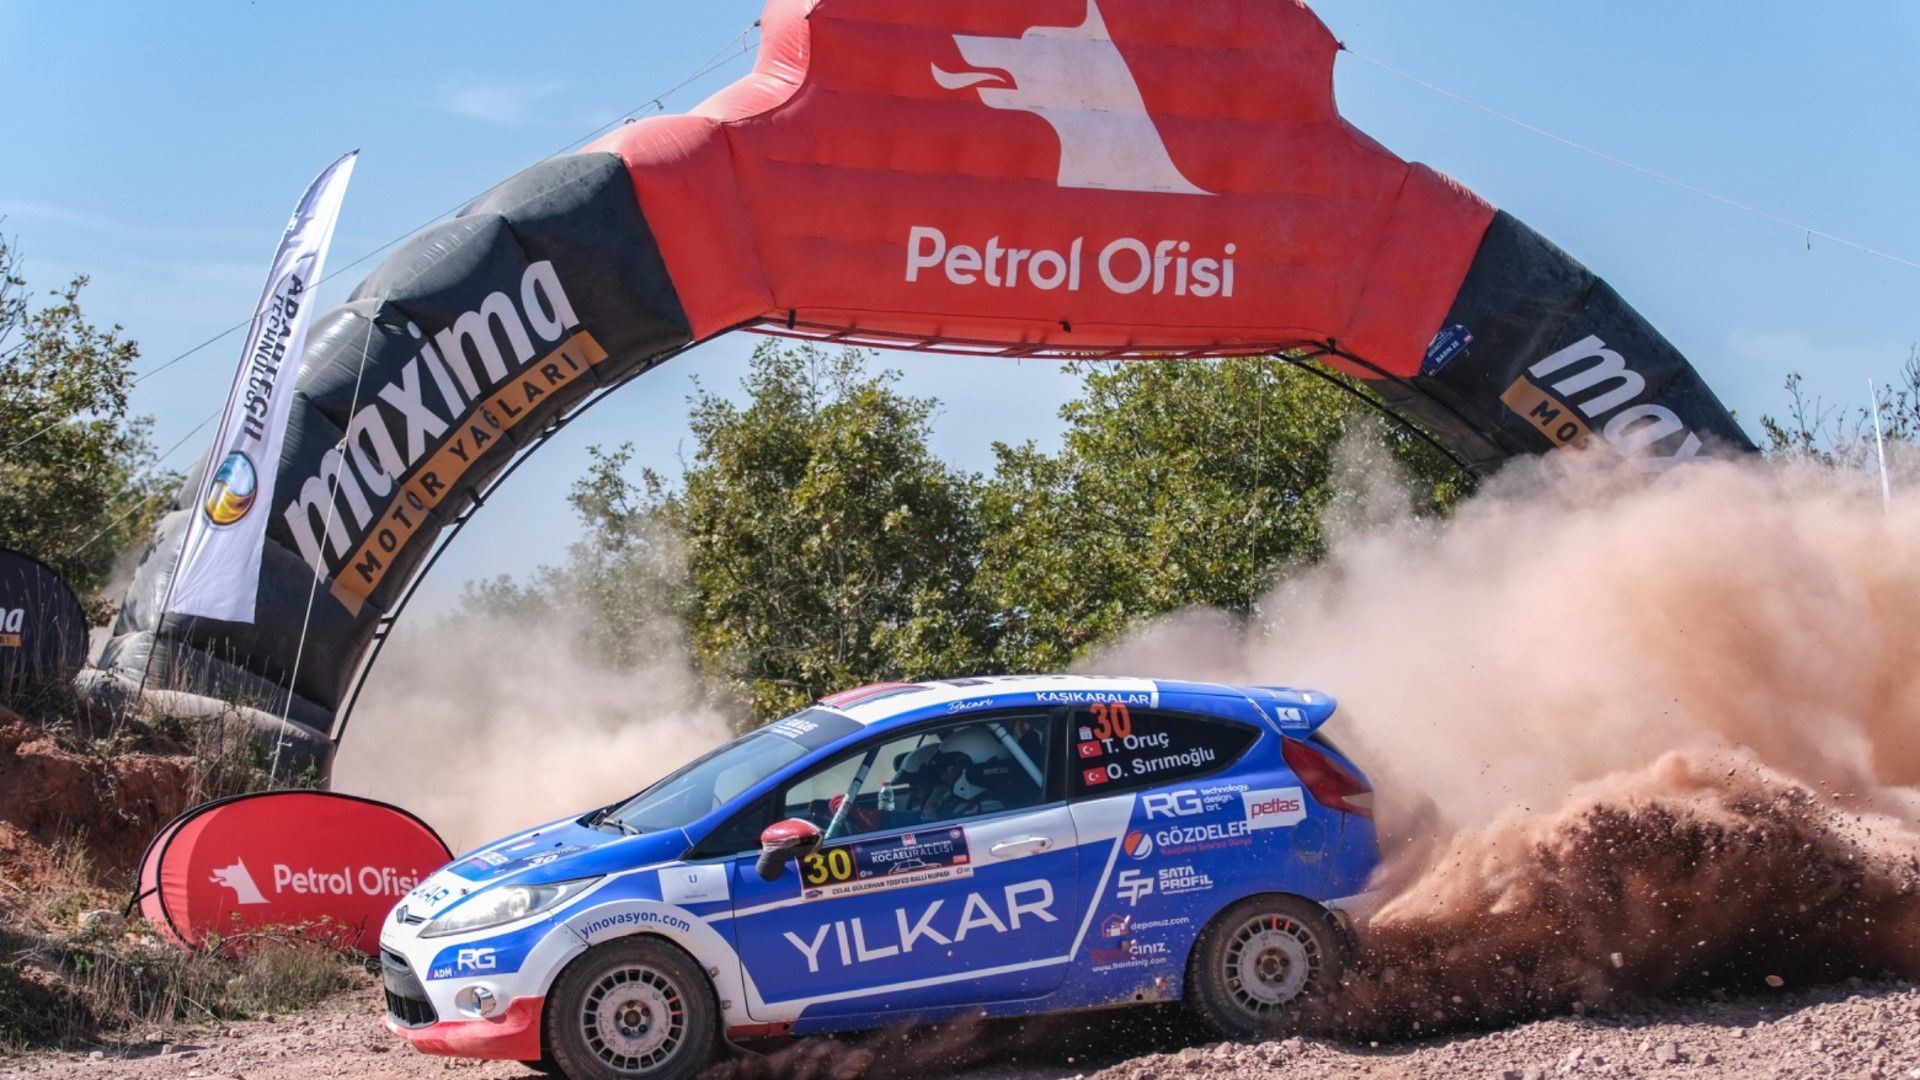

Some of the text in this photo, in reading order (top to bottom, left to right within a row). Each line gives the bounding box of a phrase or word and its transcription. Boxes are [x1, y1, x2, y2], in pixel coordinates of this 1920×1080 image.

[905, 226, 1236, 297] Petrol Ofisi
[284, 260, 580, 584] maxima
[355, 352, 580, 583] MOTOR YAĞLARI
[1036, 691, 1150, 705] KAŞIKARALAR
[1089, 701, 1132, 740] 30
[1101, 732, 1170, 754] T. Oruç
[1107, 747, 1215, 779] O. Sırımoğlu
[1142, 789, 1204, 820] RG
[1251, 798, 1300, 819] petlas
[1156, 820, 1251, 846] GÖZDELER
[273, 864, 352, 895] Petrol
[358, 866, 418, 896] Ofisi
[804, 848, 852, 884] 30
[1159, 865, 1195, 880] SATA
[581, 911, 690, 940] yinovasyon.com
[783, 878, 1058, 973] YILKAR
[457, 947, 497, 970] RG
